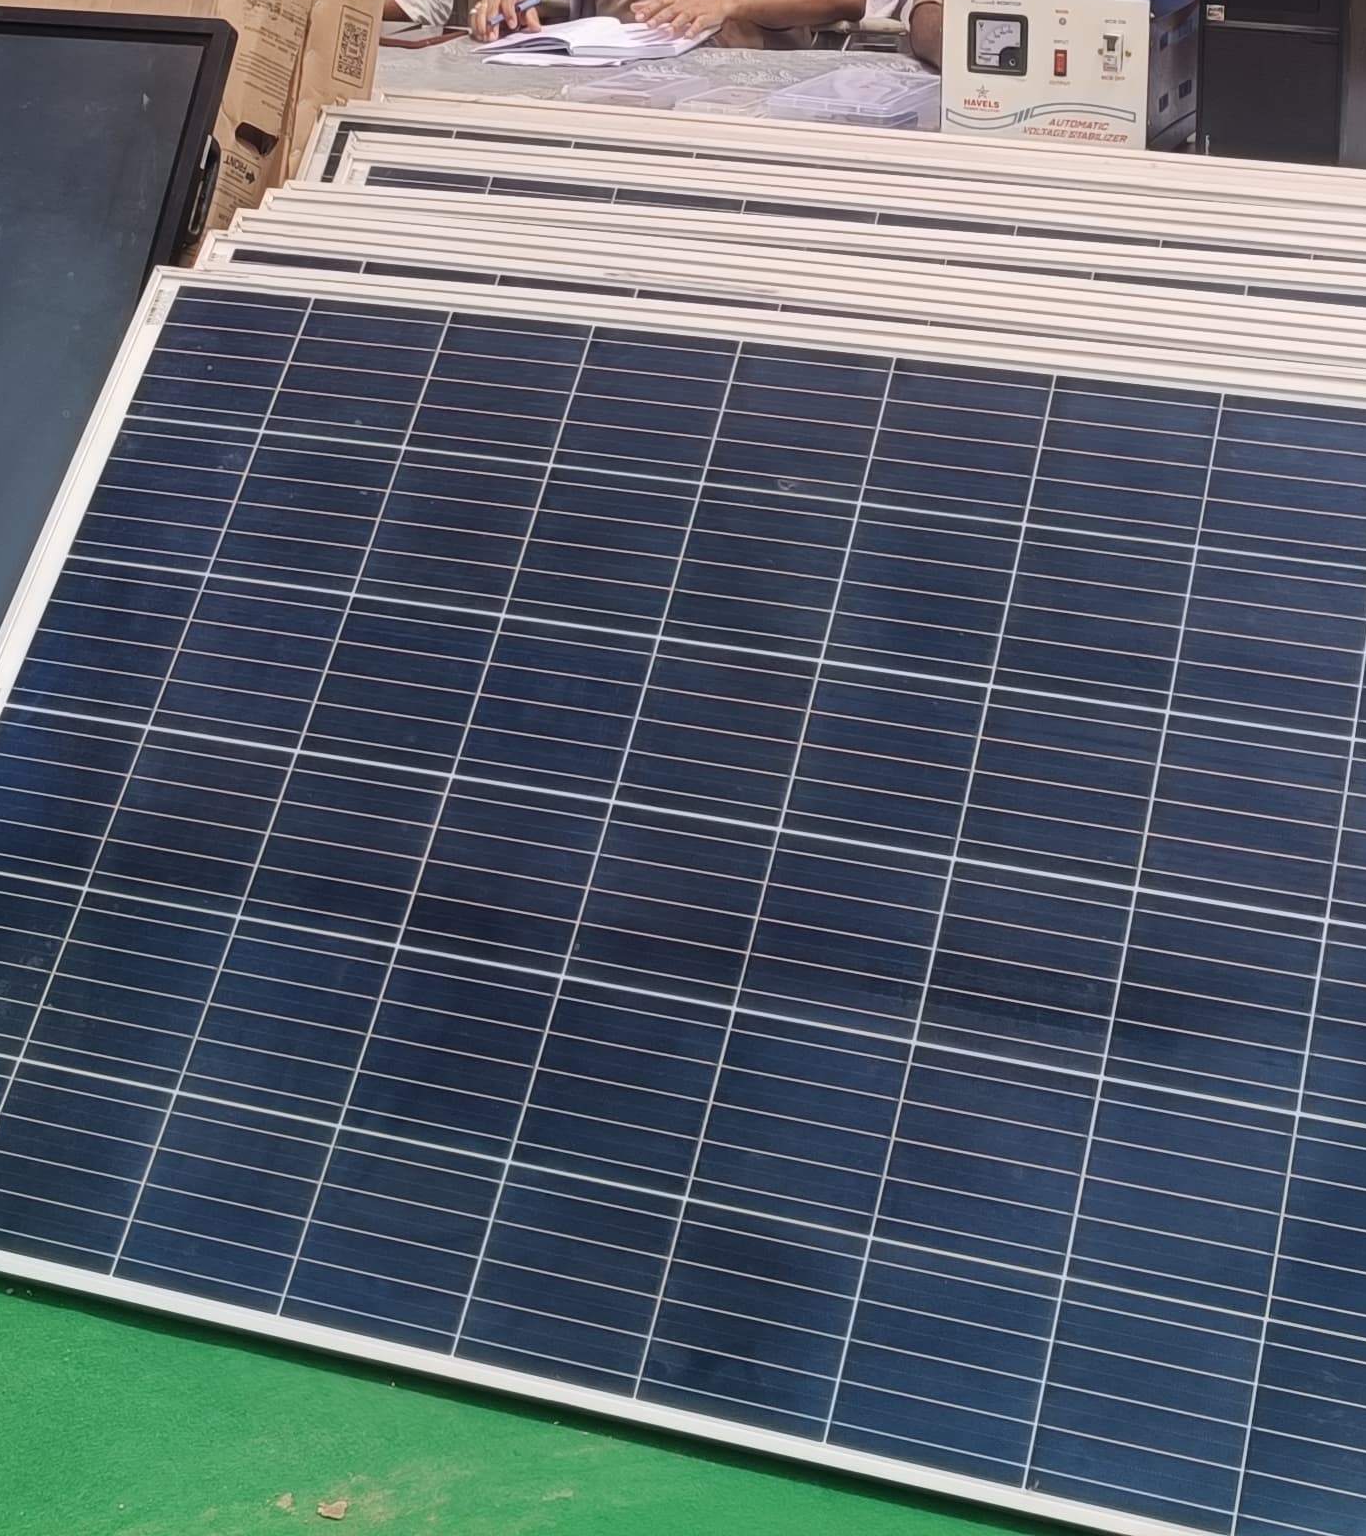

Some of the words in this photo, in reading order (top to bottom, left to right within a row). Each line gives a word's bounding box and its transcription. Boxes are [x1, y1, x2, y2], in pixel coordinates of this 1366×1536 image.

[963, 98, 1000, 109] HAVELS
[1048, 118, 1110, 131] AUTOMATIC
[1022, 127, 1067, 138] VOLTAGE
[1068, 129, 1128, 144] STABILIZER
